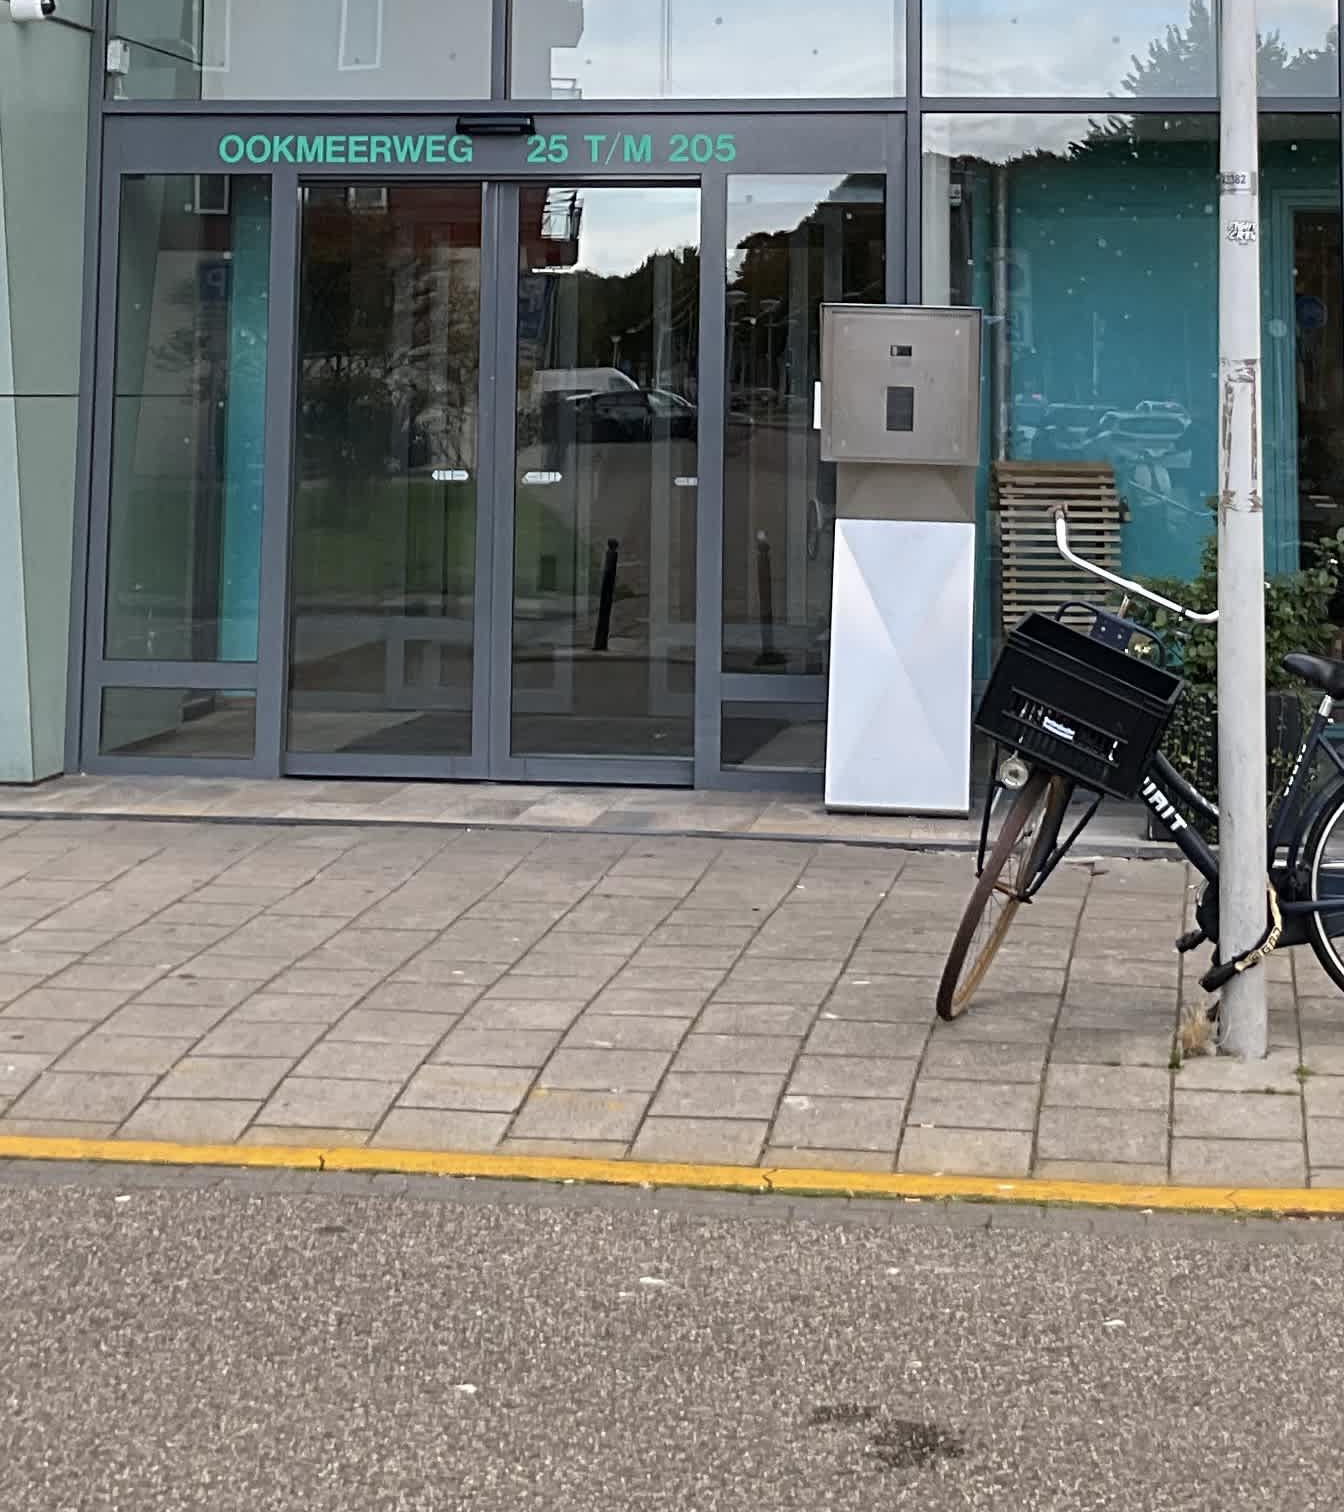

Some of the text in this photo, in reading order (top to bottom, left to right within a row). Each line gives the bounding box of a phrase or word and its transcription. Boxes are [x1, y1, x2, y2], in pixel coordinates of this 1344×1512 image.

[217, 133, 737, 164] OOKMEERWEG 25 T/M 205
[1143, 776, 1188, 831] IRIT
